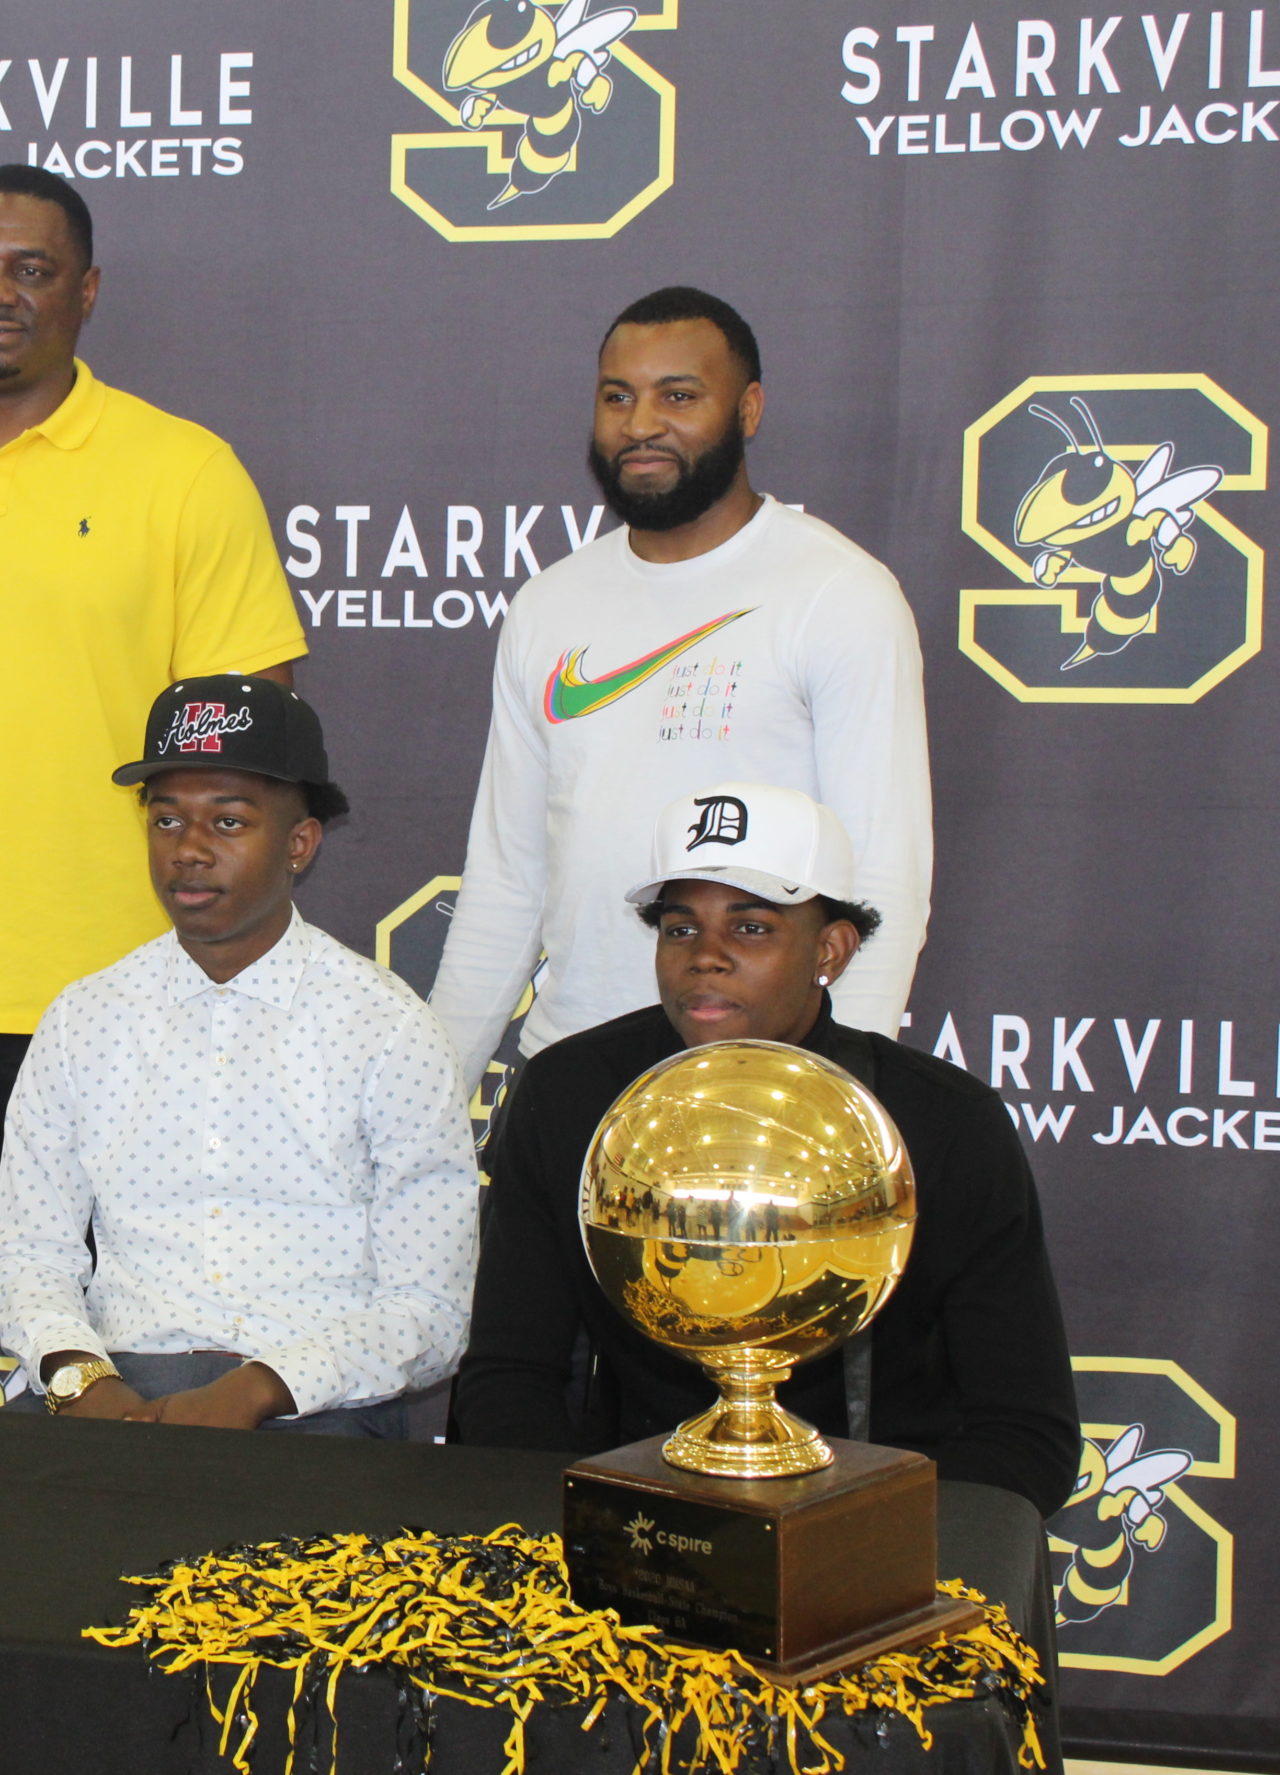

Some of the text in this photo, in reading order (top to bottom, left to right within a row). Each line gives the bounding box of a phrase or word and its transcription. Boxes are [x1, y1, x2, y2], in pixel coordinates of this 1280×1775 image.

[856, 107, 1103, 155] YELLOW
[672, 662, 699, 679] just
[730, 660, 744, 677] it
[664, 677, 737, 701] just do it
[660, 702, 687, 721] just
[720, 703, 733, 719] it
[157, 705, 253, 755] Holmes
[656, 723, 684, 743] just
[689, 719, 713, 740] do
[685, 795, 749, 852] D
